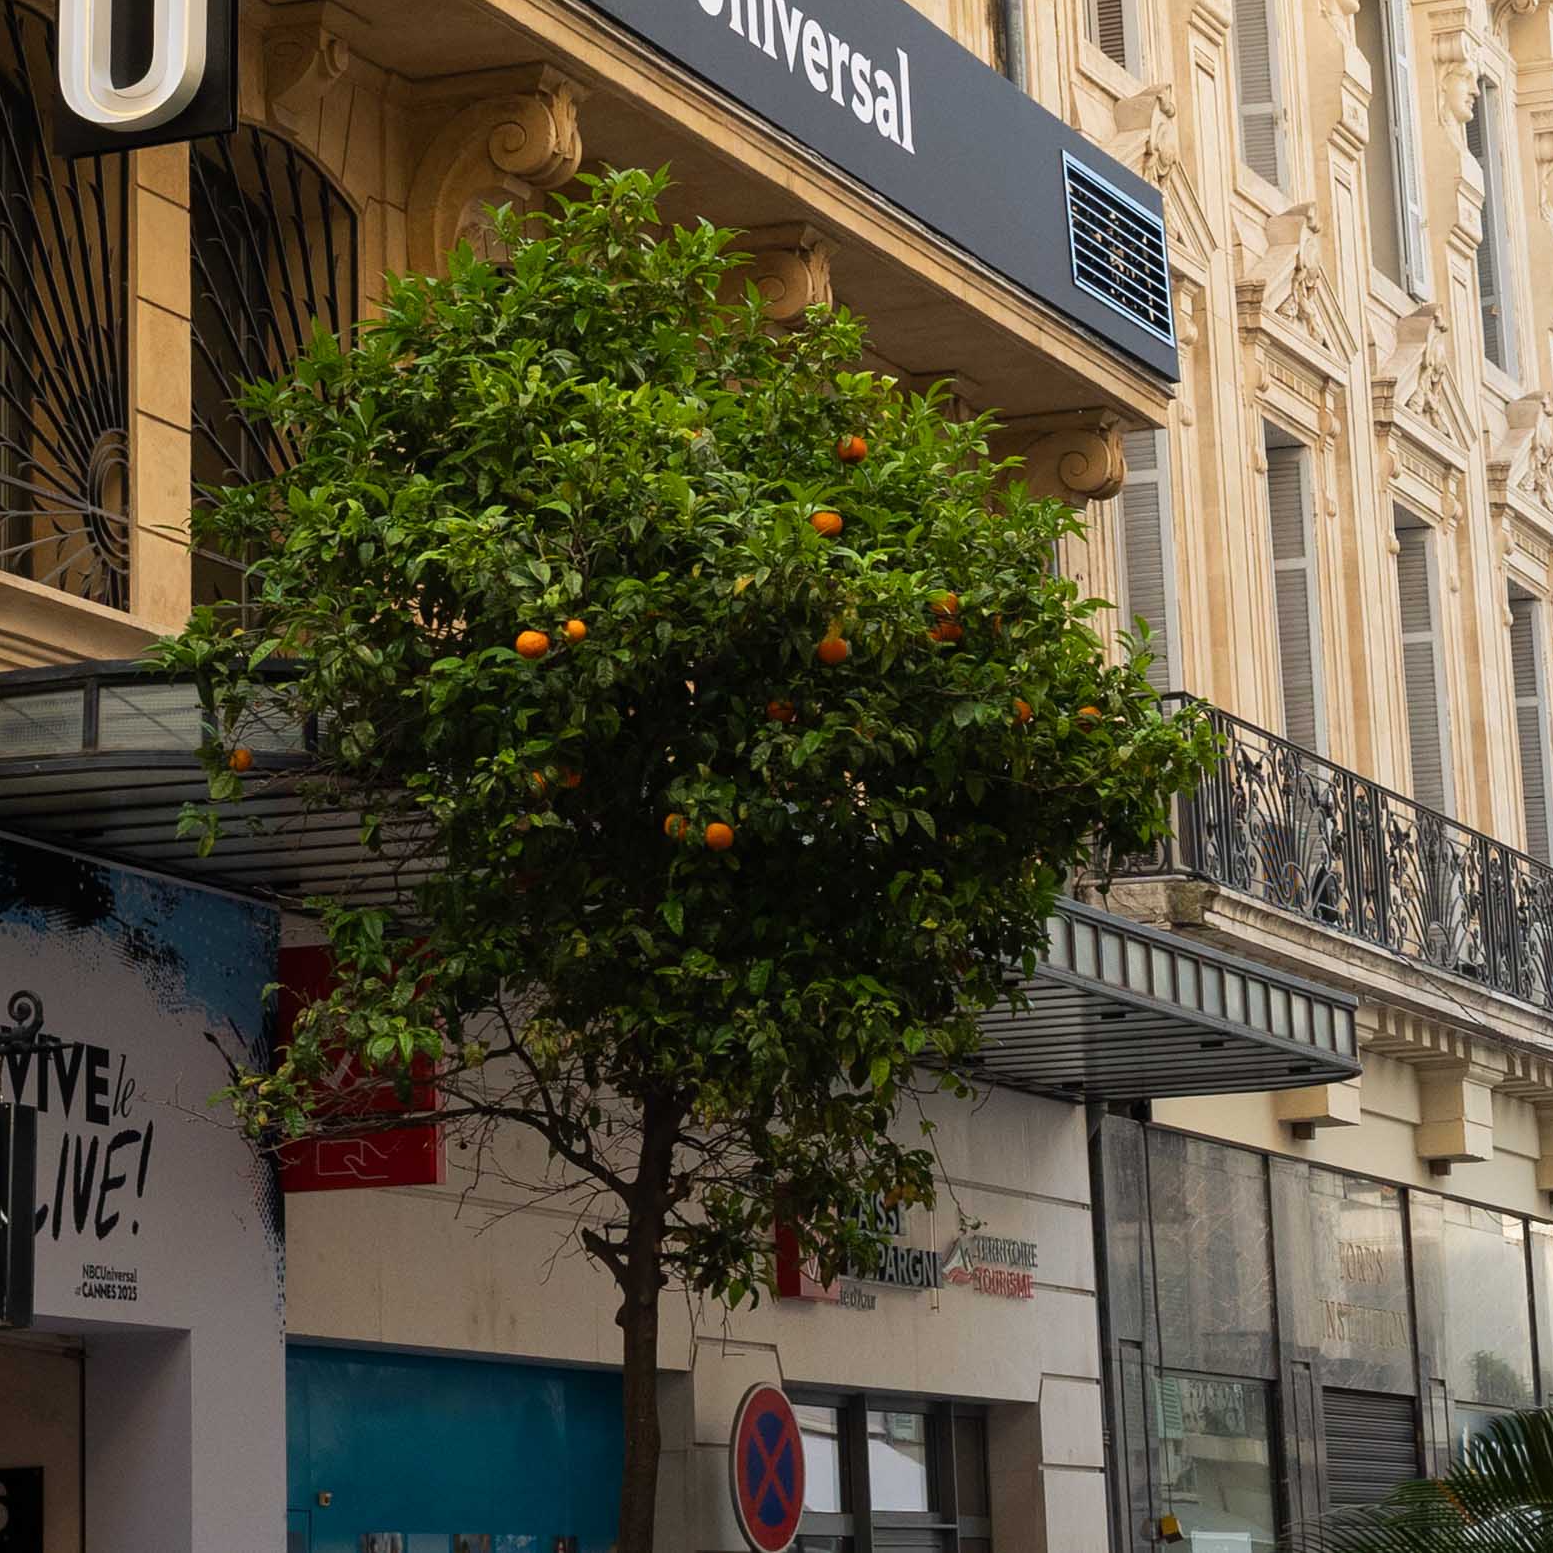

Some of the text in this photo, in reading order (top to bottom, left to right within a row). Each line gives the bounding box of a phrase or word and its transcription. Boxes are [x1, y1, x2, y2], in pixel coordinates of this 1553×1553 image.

[113, 1053, 136, 1119] le
[34, 1119, 154, 1241] IVE!
[82, 1264, 138, 1283] NBCUniversal
[974, 1267, 1035, 1299] TOURISME
[82, 1281, 116, 1299] CANNES
